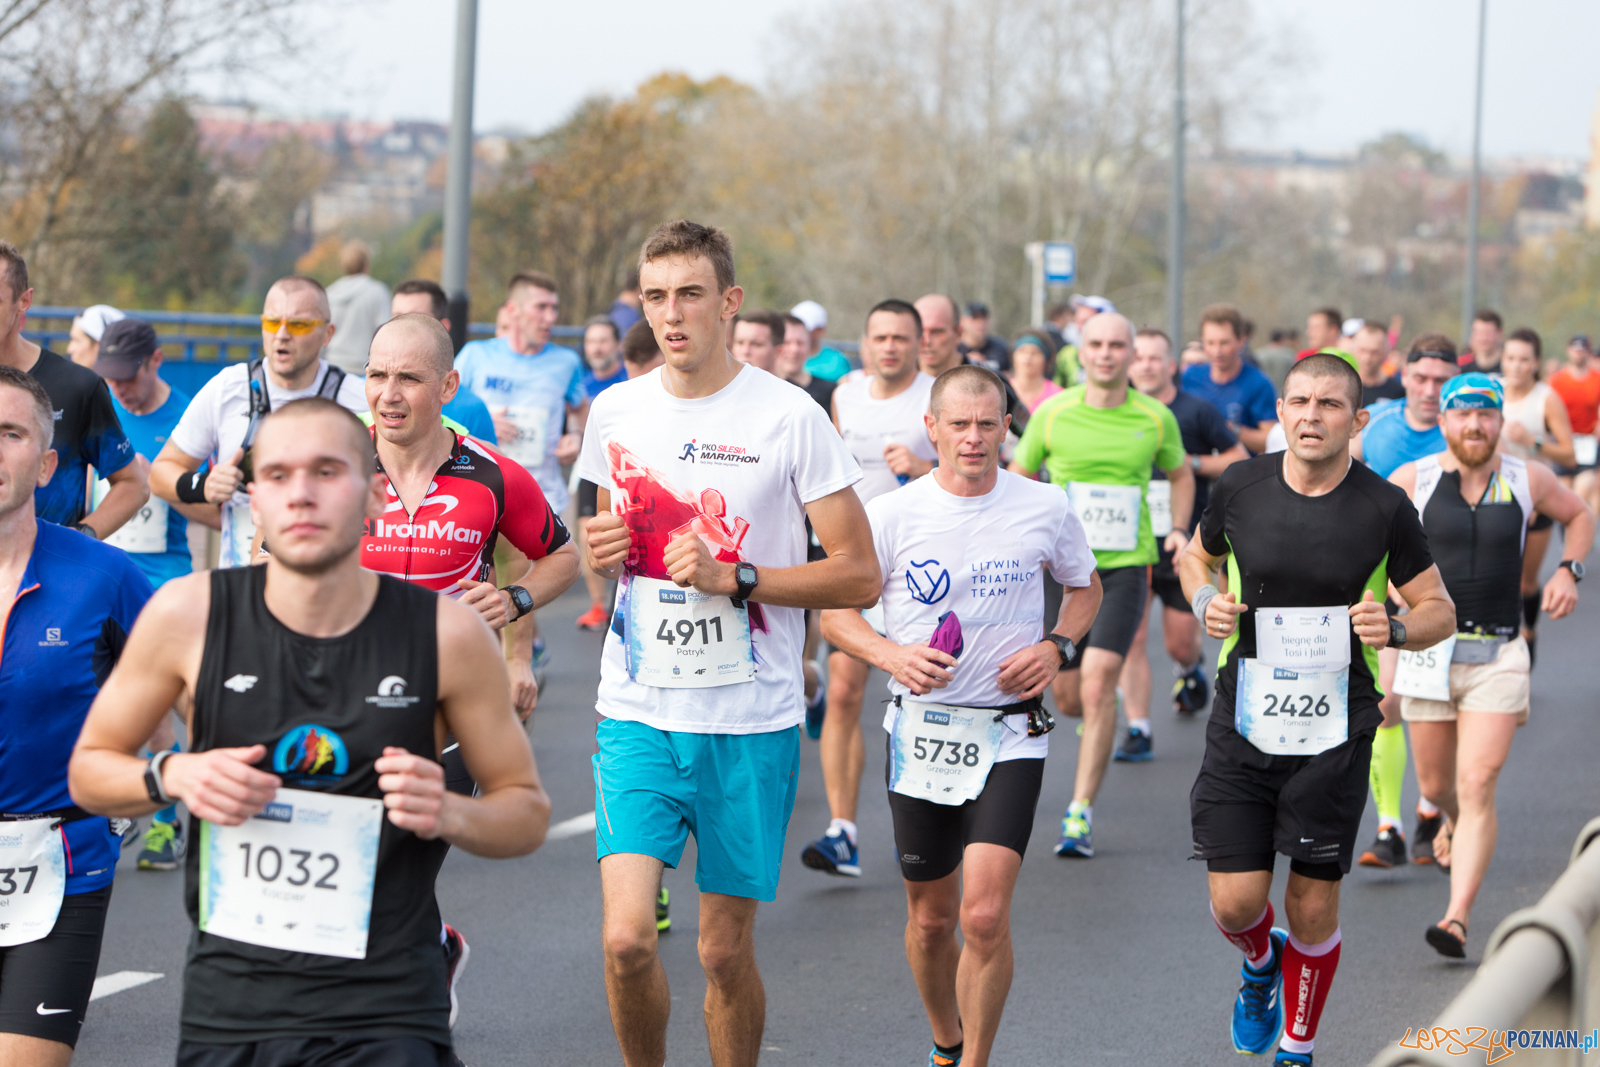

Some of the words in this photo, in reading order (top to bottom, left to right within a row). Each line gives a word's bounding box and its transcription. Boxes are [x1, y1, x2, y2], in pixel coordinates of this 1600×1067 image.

[702, 444, 716, 452] PKO
[717, 444, 746, 455] SILESIA
[700, 452, 760, 464] MARATHON
[1083, 507, 1127, 524] 6734
[366, 543, 451, 557] Celironman.pl
[971, 559, 1019, 572] LITWIN
[971, 587, 1007, 598] TEAM
[656, 616, 723, 646] 4911
[1281, 634, 1311, 647] biegnę
[1313, 634, 1327, 644] dla
[676, 648, 706, 658] Patryk
[1285, 647, 1302, 657] Tosi
[1310, 647, 1326, 659] Julii
[1262, 693, 1331, 717] 2426
[1282, 718, 1311, 727] Tomasz
[913, 736, 980, 768] 5738
[926, 764, 963, 776] Grzegorz
[239, 842, 339, 890] 1032
[0, 865, 38, 896] 37
